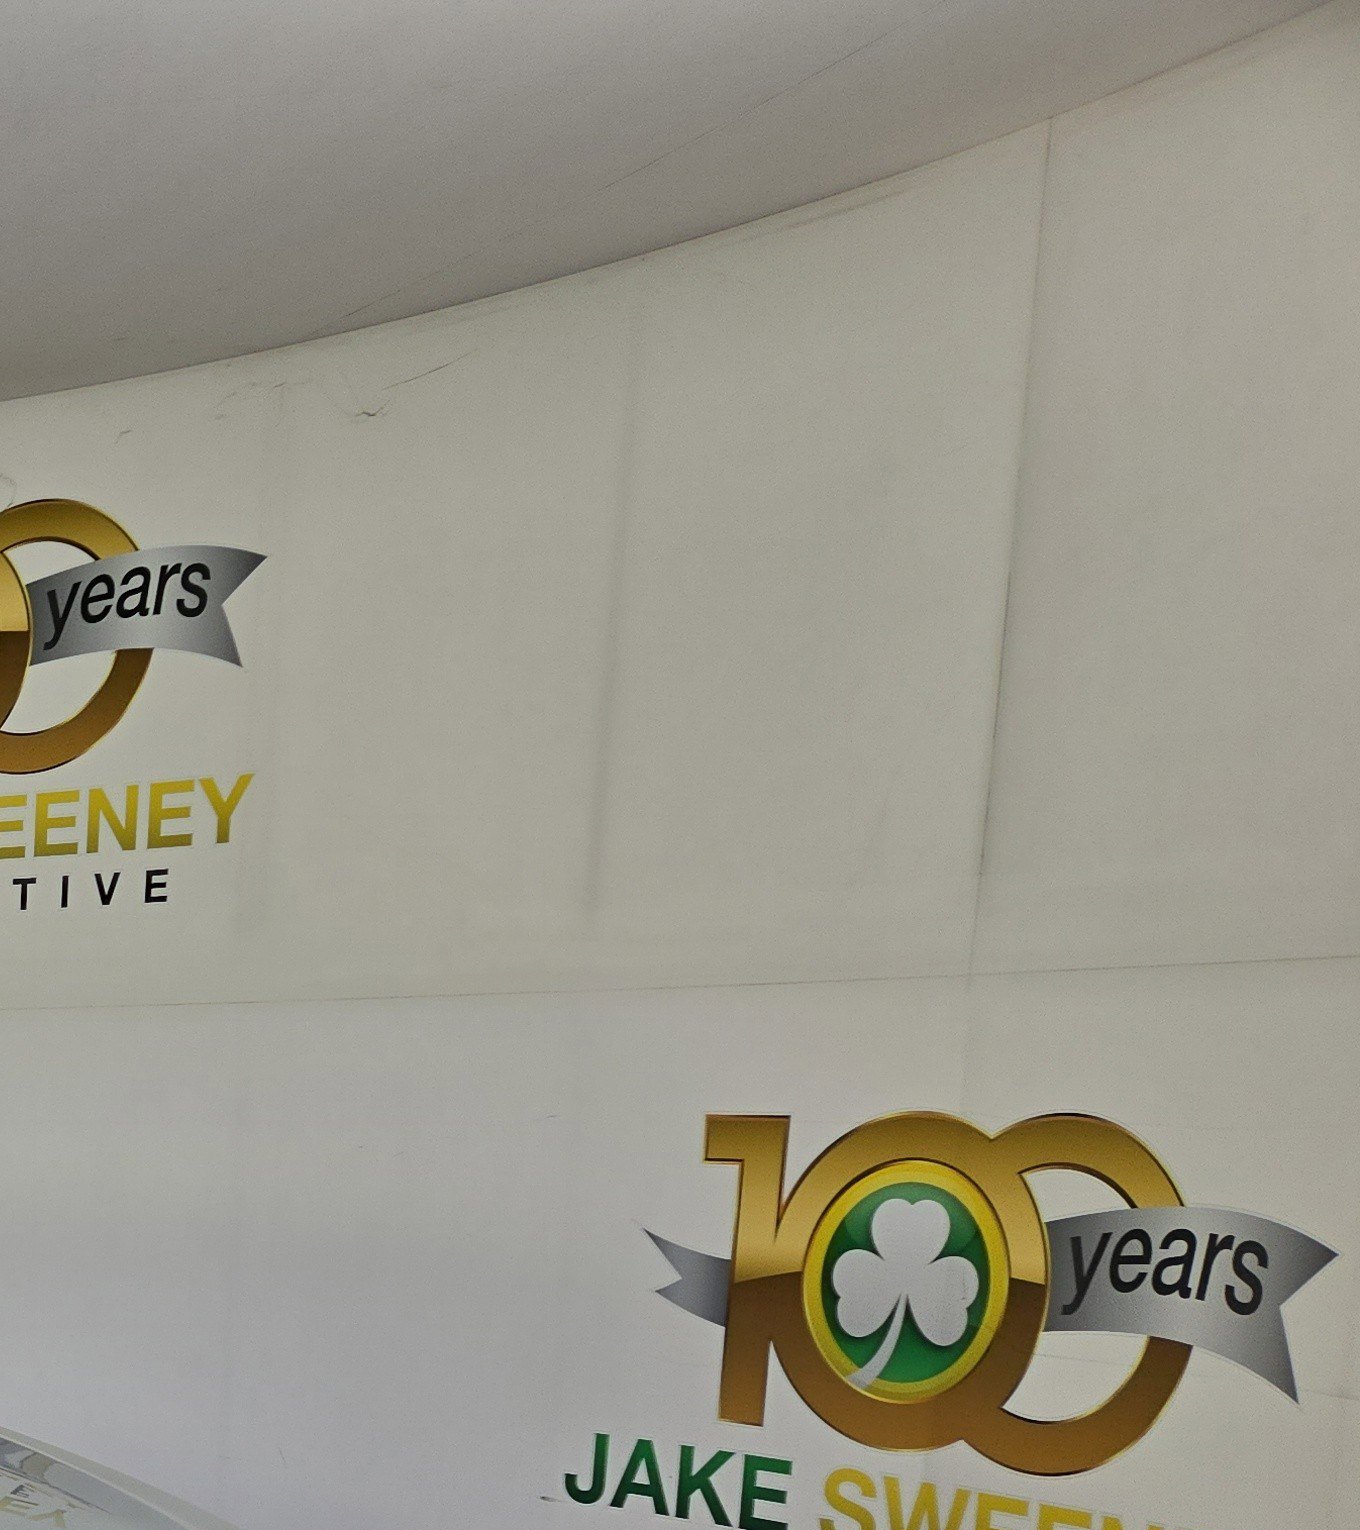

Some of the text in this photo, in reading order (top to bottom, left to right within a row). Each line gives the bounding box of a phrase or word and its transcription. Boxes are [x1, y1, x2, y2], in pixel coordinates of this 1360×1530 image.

[44, 559, 212, 650] years
[705, 1111, 1270, 1477] 100 years
